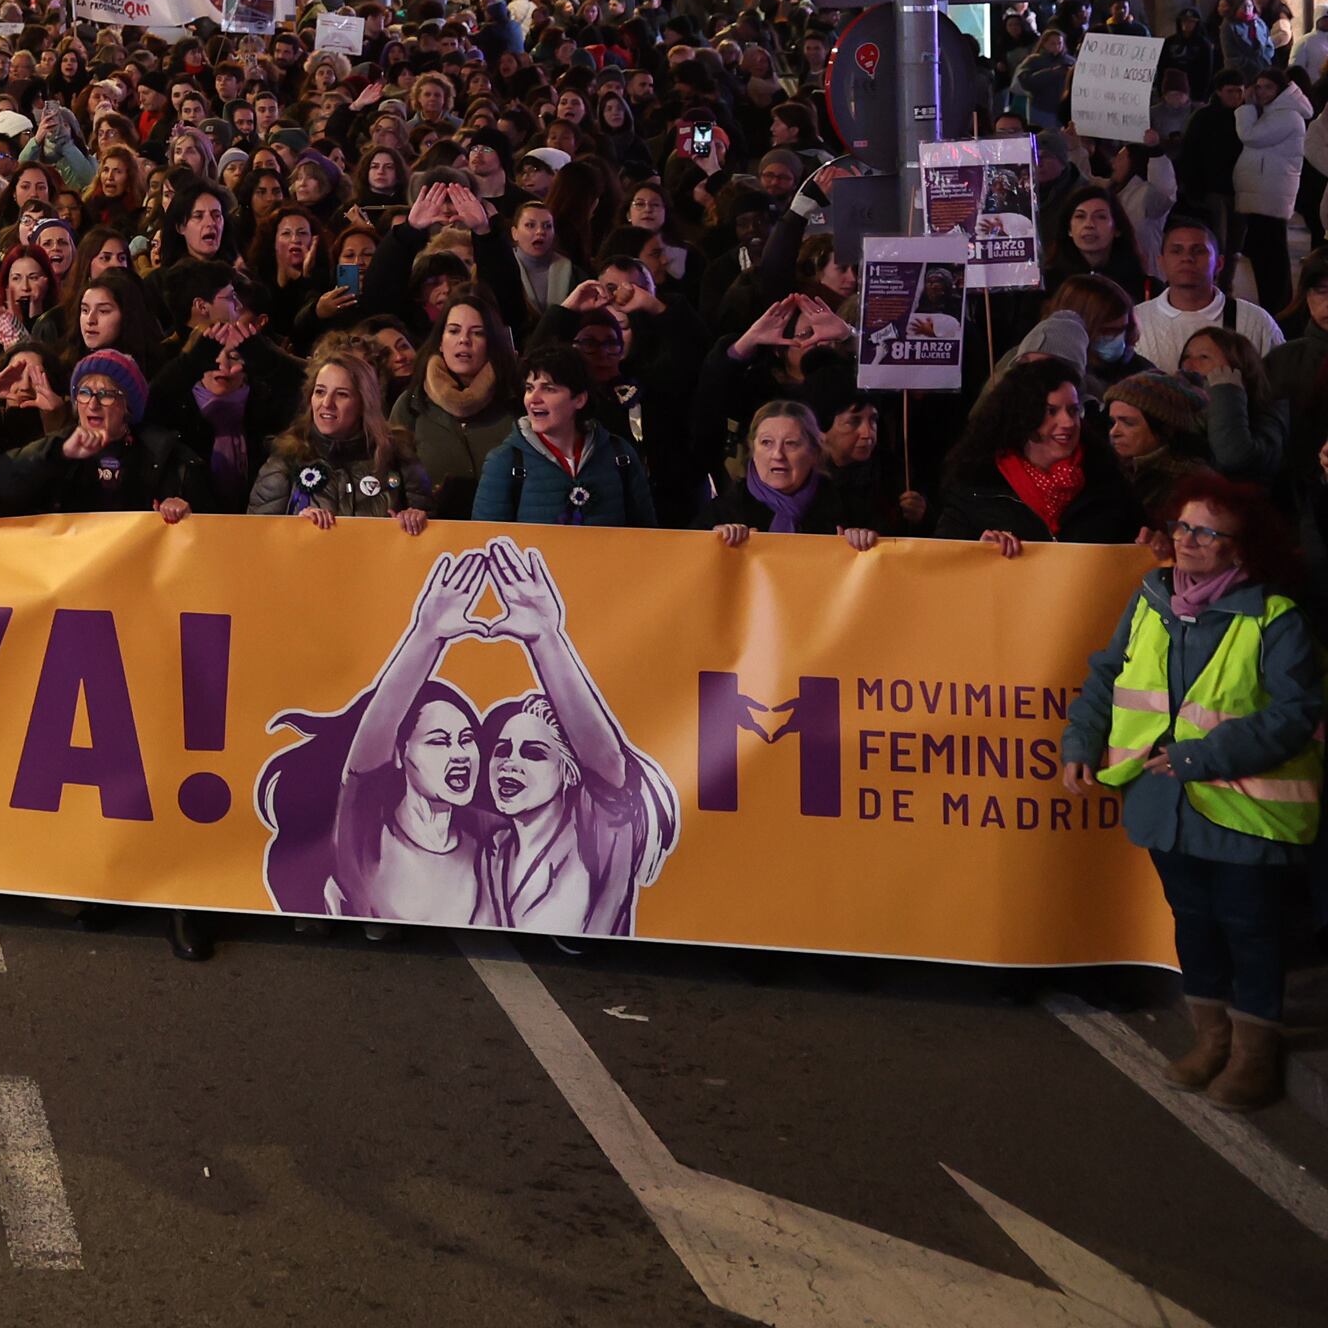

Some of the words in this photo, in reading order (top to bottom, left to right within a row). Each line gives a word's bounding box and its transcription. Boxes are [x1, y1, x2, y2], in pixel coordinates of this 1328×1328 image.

[1085, 40, 1098, 53] NO
[1124, 68, 1155, 83] ACOSEN
[856, 677, 1082, 721] MOVIMIEN
[858, 729, 1060, 781] FEMINIS
[858, 787, 915, 823] DE
[942, 792, 1120, 831] MADRID
